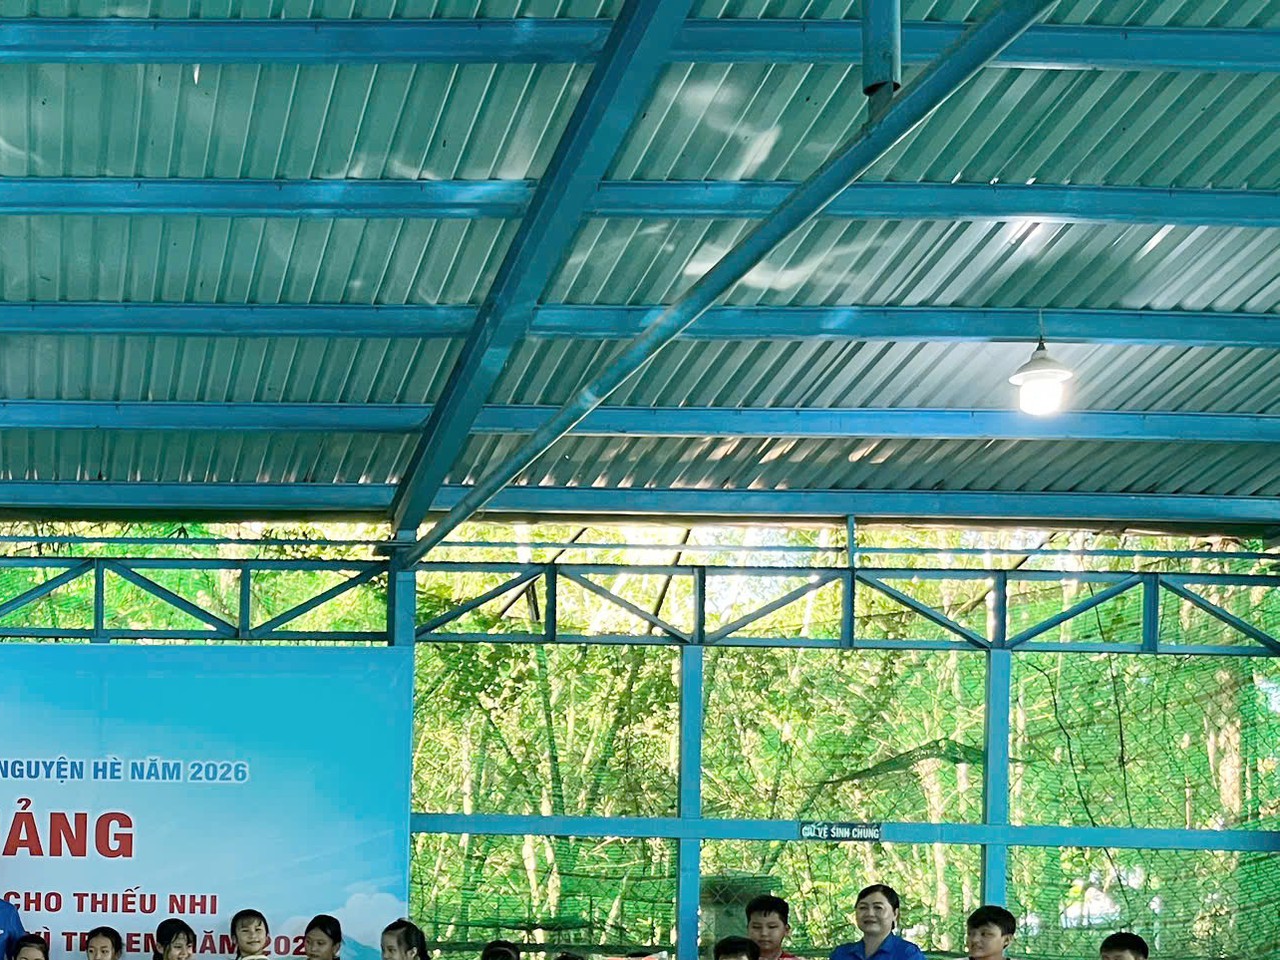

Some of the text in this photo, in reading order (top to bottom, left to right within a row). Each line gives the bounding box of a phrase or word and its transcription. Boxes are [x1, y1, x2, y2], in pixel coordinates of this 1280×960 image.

[92, 756, 122, 780] HÈ
[130, 757, 182, 781] NĂM
[189, 762, 248, 782] 2026
[830, 827, 850, 838] SINH
[851, 827, 880, 839] CHUNG
[73, 885, 157, 914] THIẾU
[169, 894, 218, 915] NHI
